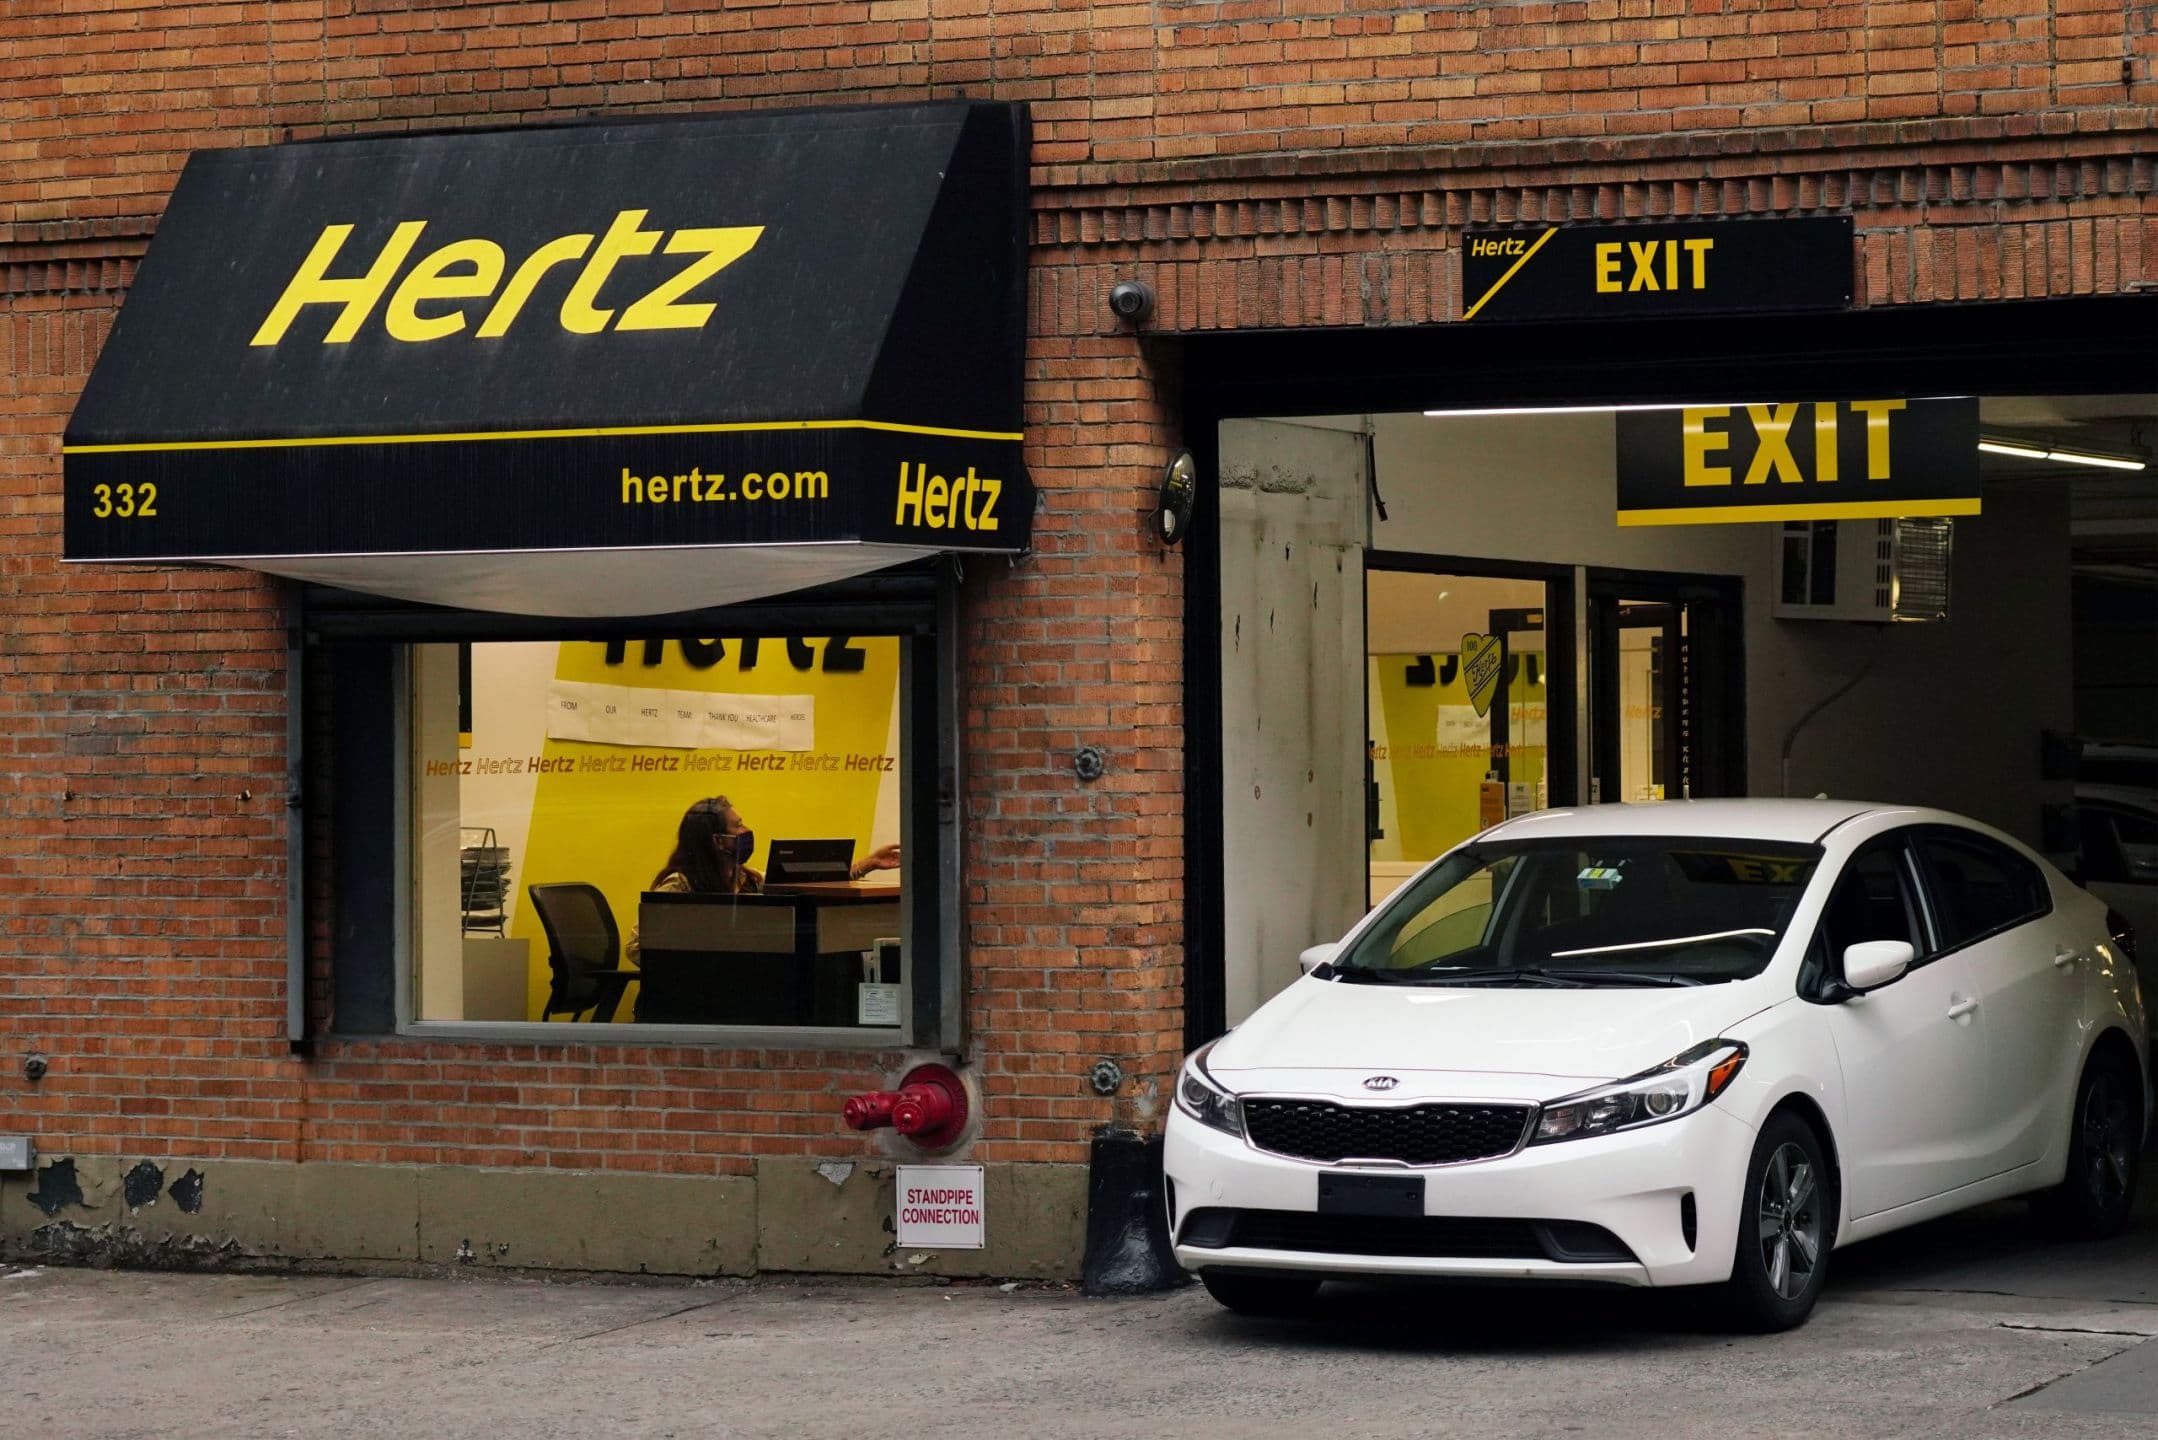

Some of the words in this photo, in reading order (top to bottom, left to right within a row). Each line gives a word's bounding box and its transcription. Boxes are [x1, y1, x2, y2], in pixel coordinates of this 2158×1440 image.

[1471, 237, 1526, 257] Hertz
[249, 209, 766, 347] Hertz
[1595, 238, 1714, 293] EXIT
[1682, 400, 1907, 487] EXIT
[93, 482, 158, 518] 332
[621, 467, 829, 504] hertz.com
[896, 461, 1002, 530] Hertz
[560, 701, 578, 711] FROM
[605, 704, 617, 715] OUR
[641, 708, 658, 718] HERTZ
[708, 711, 726, 722] THANK
[727, 712, 739, 722] YOU
[426, 760, 473, 776] Hertz
[528, 756, 575, 773] Hertz
[631, 754, 680, 771] Hertz
[737, 753, 786, 771] Hertz
[845, 753, 895, 772] Hertz
[1367, 1076, 1393, 1087] KIA
[907, 1188, 973, 1204] STANDPIPE
[902, 1208, 979, 1225] CONNECTION
